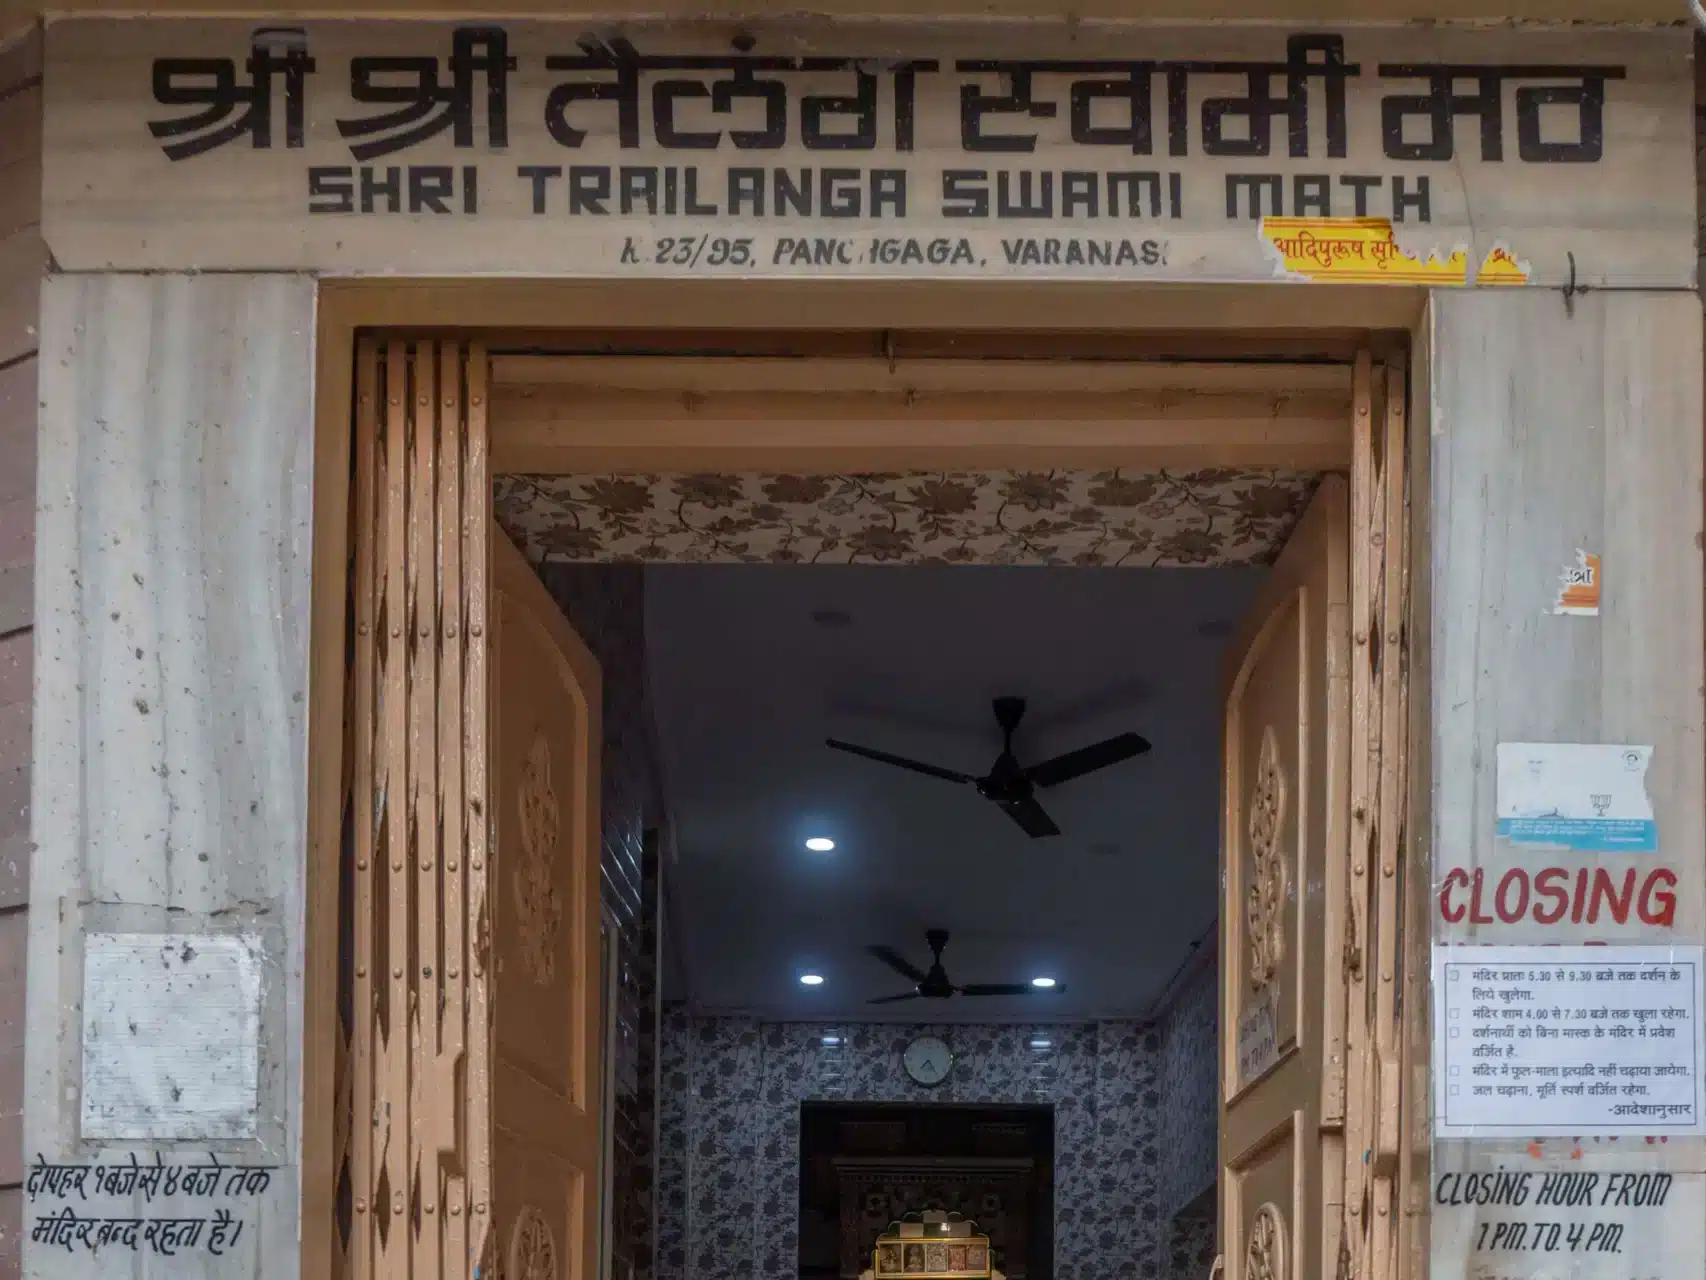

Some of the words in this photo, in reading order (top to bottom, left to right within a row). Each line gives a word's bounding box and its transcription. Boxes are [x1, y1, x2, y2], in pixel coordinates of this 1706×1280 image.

[335, 25, 518, 161] श्री
[955, 33, 1361, 160] स्वामी
[1378, 64, 1627, 163] मठ
[306, 164, 480, 216] SHRI
[516, 163, 908, 218] TRAILANGA
[940, 166, 1184, 221] SWAMI
[1224, 170, 1434, 224] MATH
[1439, 867, 1679, 926] CLOSING
[1472, 967, 1498, 982] मंदिर
[1527, 970, 1552, 982] 5.30
[1555, 968, 1565, 981] से
[1568, 970, 1593, 982] 9.30
[1595, 967, 1615, 982] बजे
[1617, 970, 1637, 982] तक
[1639, 967, 1668, 982] दर्शन
[1670, 968, 1681, 981] के
[1472, 987, 1495, 1001] लिये
[1472, 1005, 1498, 1020] मंदिर
[1501, 1009, 1524, 1020] शाम
[1525, 1009, 1549, 1020] 4.00
[1552, 1006, 1561, 1019] से
[1563, 1008, 1588, 1020] 7.30
[1589, 1005, 1609, 1020] बजे
[1611, 1009, 1631, 1020] तक
[1632, 1009, 1658, 1023] खुला
[1518, 1025, 1532, 1038] को
[1535, 1024, 1560, 1039] बिना
[1562, 1028, 1592, 1039] मास्क
[1594, 1025, 1605, 1038] के
[1608, 1025, 1635, 1039] मंदिर
[1638, 1025, 1646, 1038] में
[1650, 1025, 1675, 1038] प्रवेश
[1472, 1044, 1502, 1057] वर्जित
[1471, 1062, 1498, 1077] मंदिर
[1501, 1063, 1509, 1077] में
[1561, 1063, 1596, 1079] इत्यादि
[1598, 1063, 1617, 1078] नहीं
[1472, 1085, 1493, 1096] जल
[1535, 1081, 1558, 1100] मूर्ति
[1559, 1081, 1585, 1096] स्पर्श
[1587, 1081, 1618, 1096] वर्जित
[26, 1151, 92, 1203] दोपहर
[104, 1151, 139, 1197] बजे
[137, 1150, 166, 1204] से
[180, 1151, 232, 1197] बजे
[224, 1164, 280, 1196] तक
[1535, 1171, 1599, 1208] HOUR
[1600, 1171, 1673, 1208] FROM
[31, 1205, 102, 1254] मंदिर
[143, 1217, 207, 1257] रहता
[1476, 1222, 1489, 1252] 1
[1565, 1222, 1585, 1253] 4
[1585, 1222, 1625, 1254] PM.
